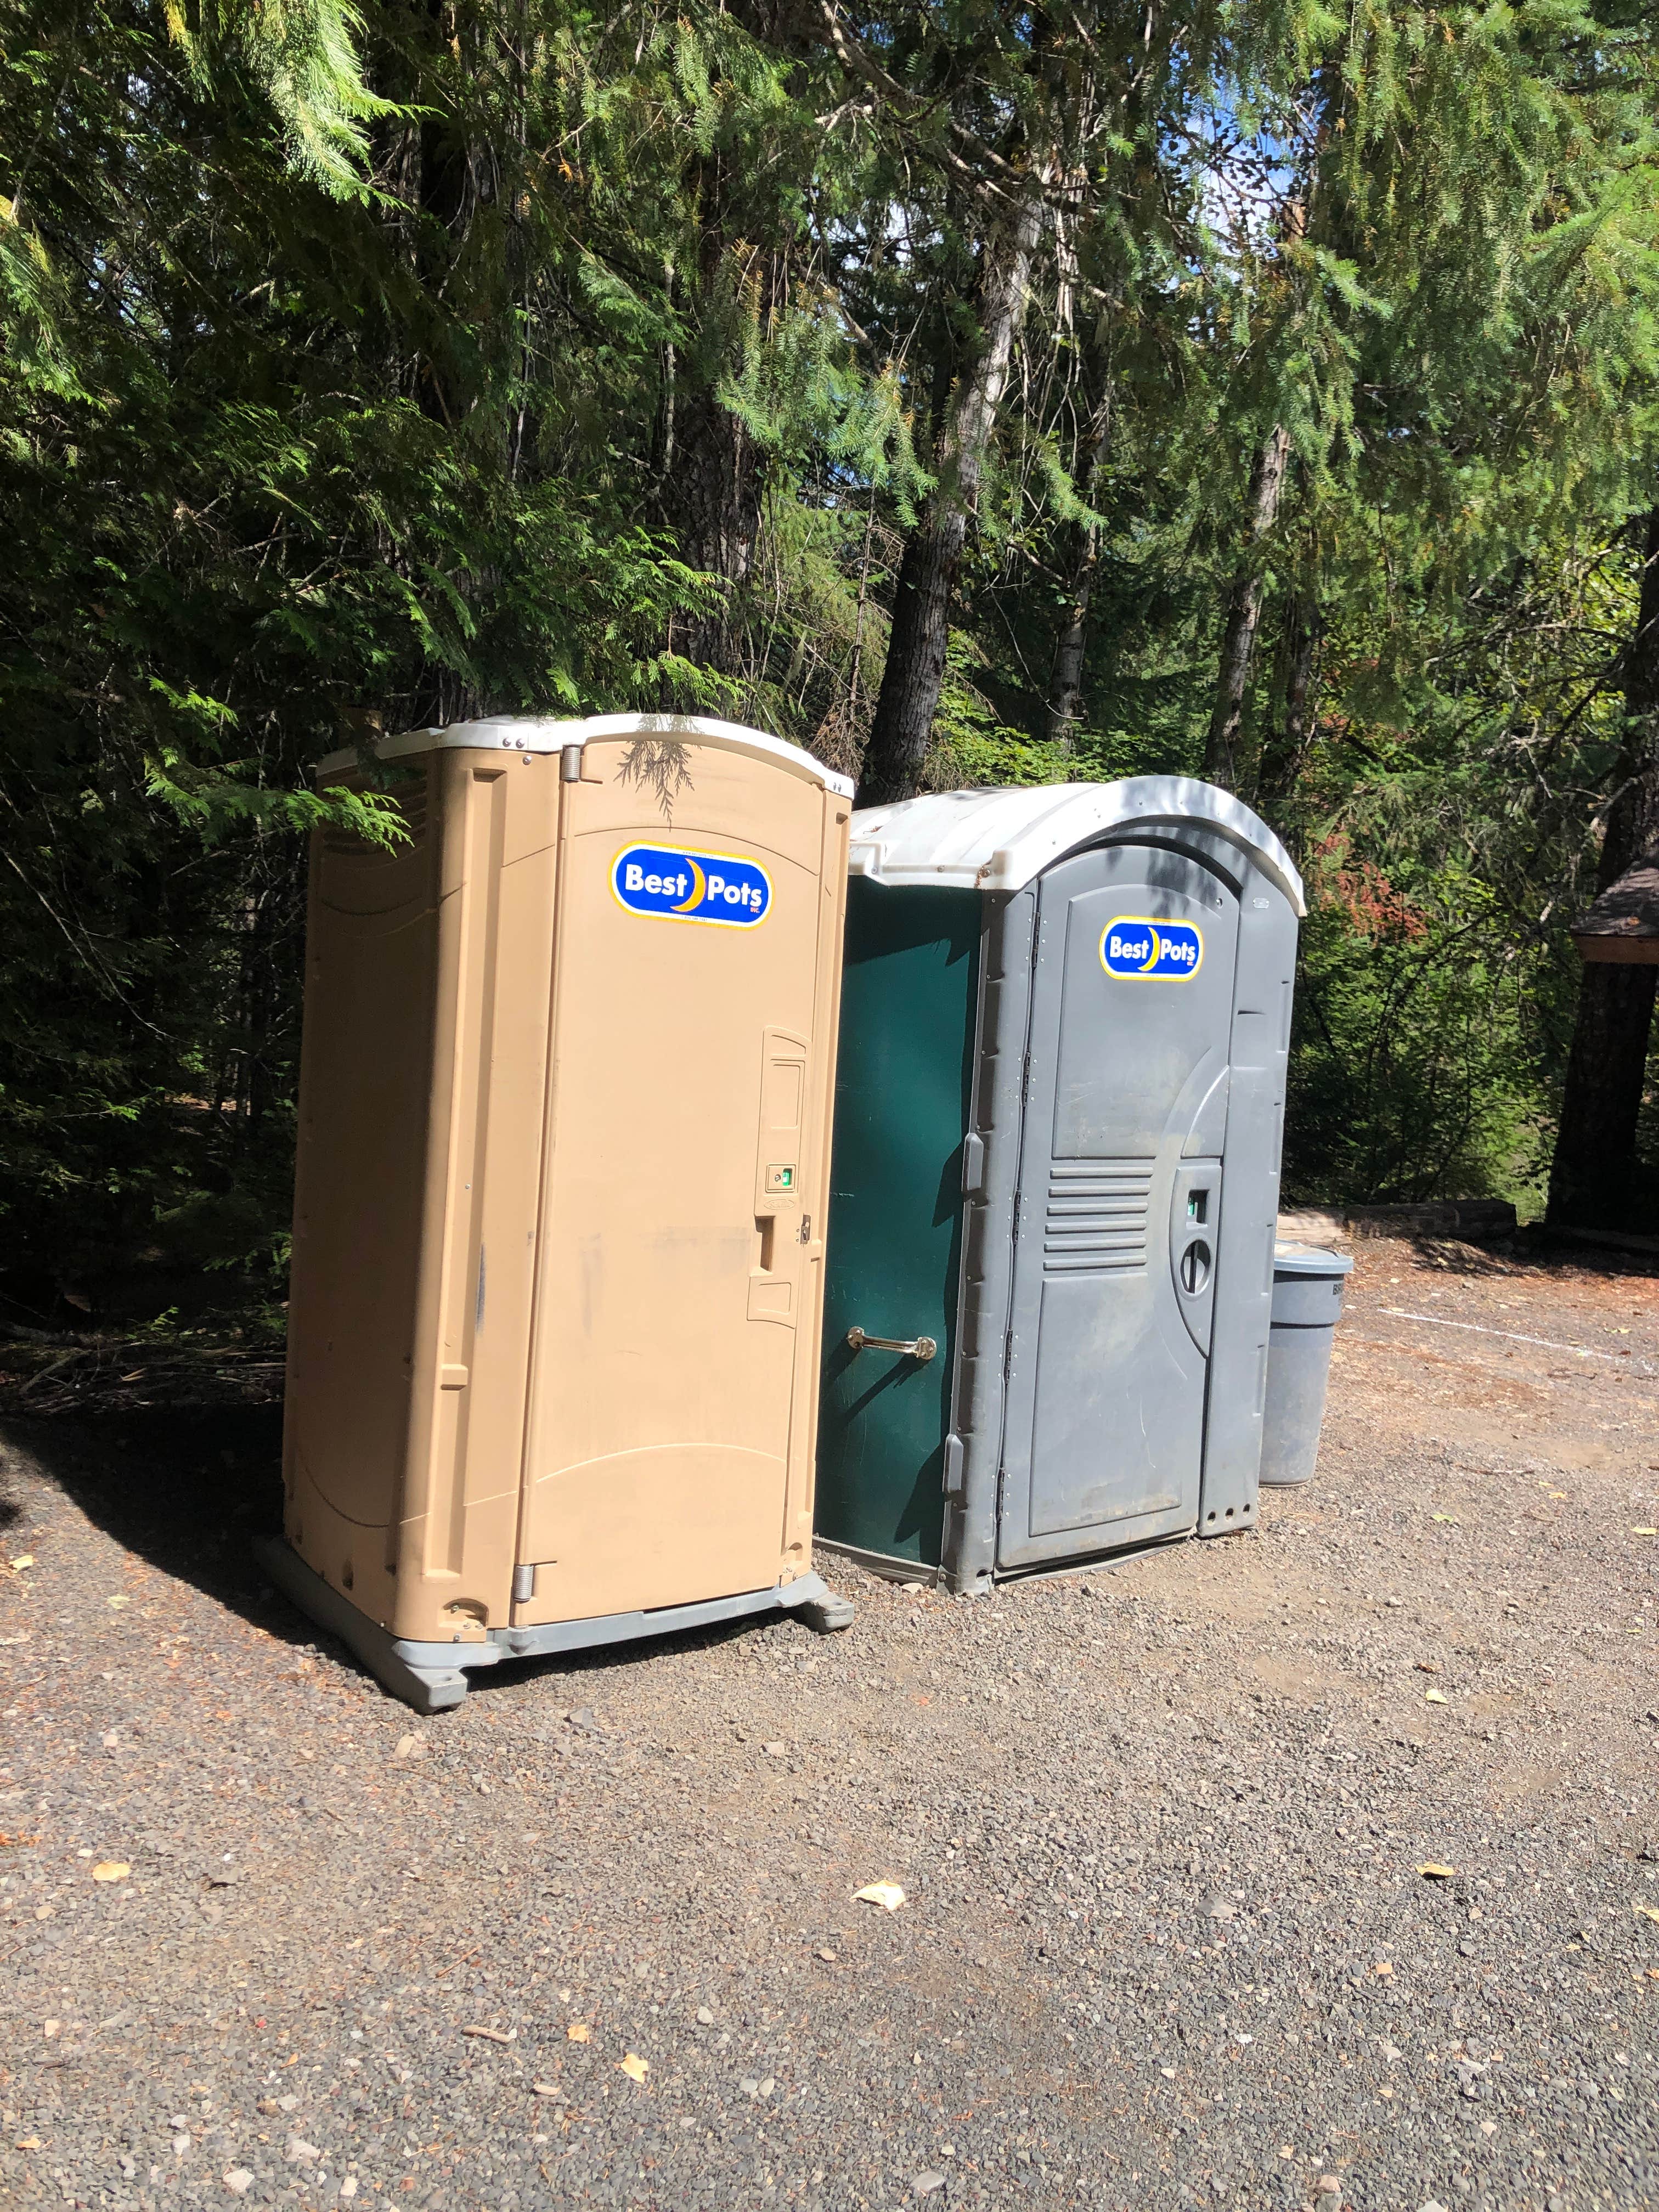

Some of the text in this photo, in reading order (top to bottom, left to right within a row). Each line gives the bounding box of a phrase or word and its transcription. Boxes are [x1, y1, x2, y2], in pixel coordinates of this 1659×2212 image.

[625, 864, 763, 907] Best Pots
[1109, 936, 1195, 961] Best Pots
